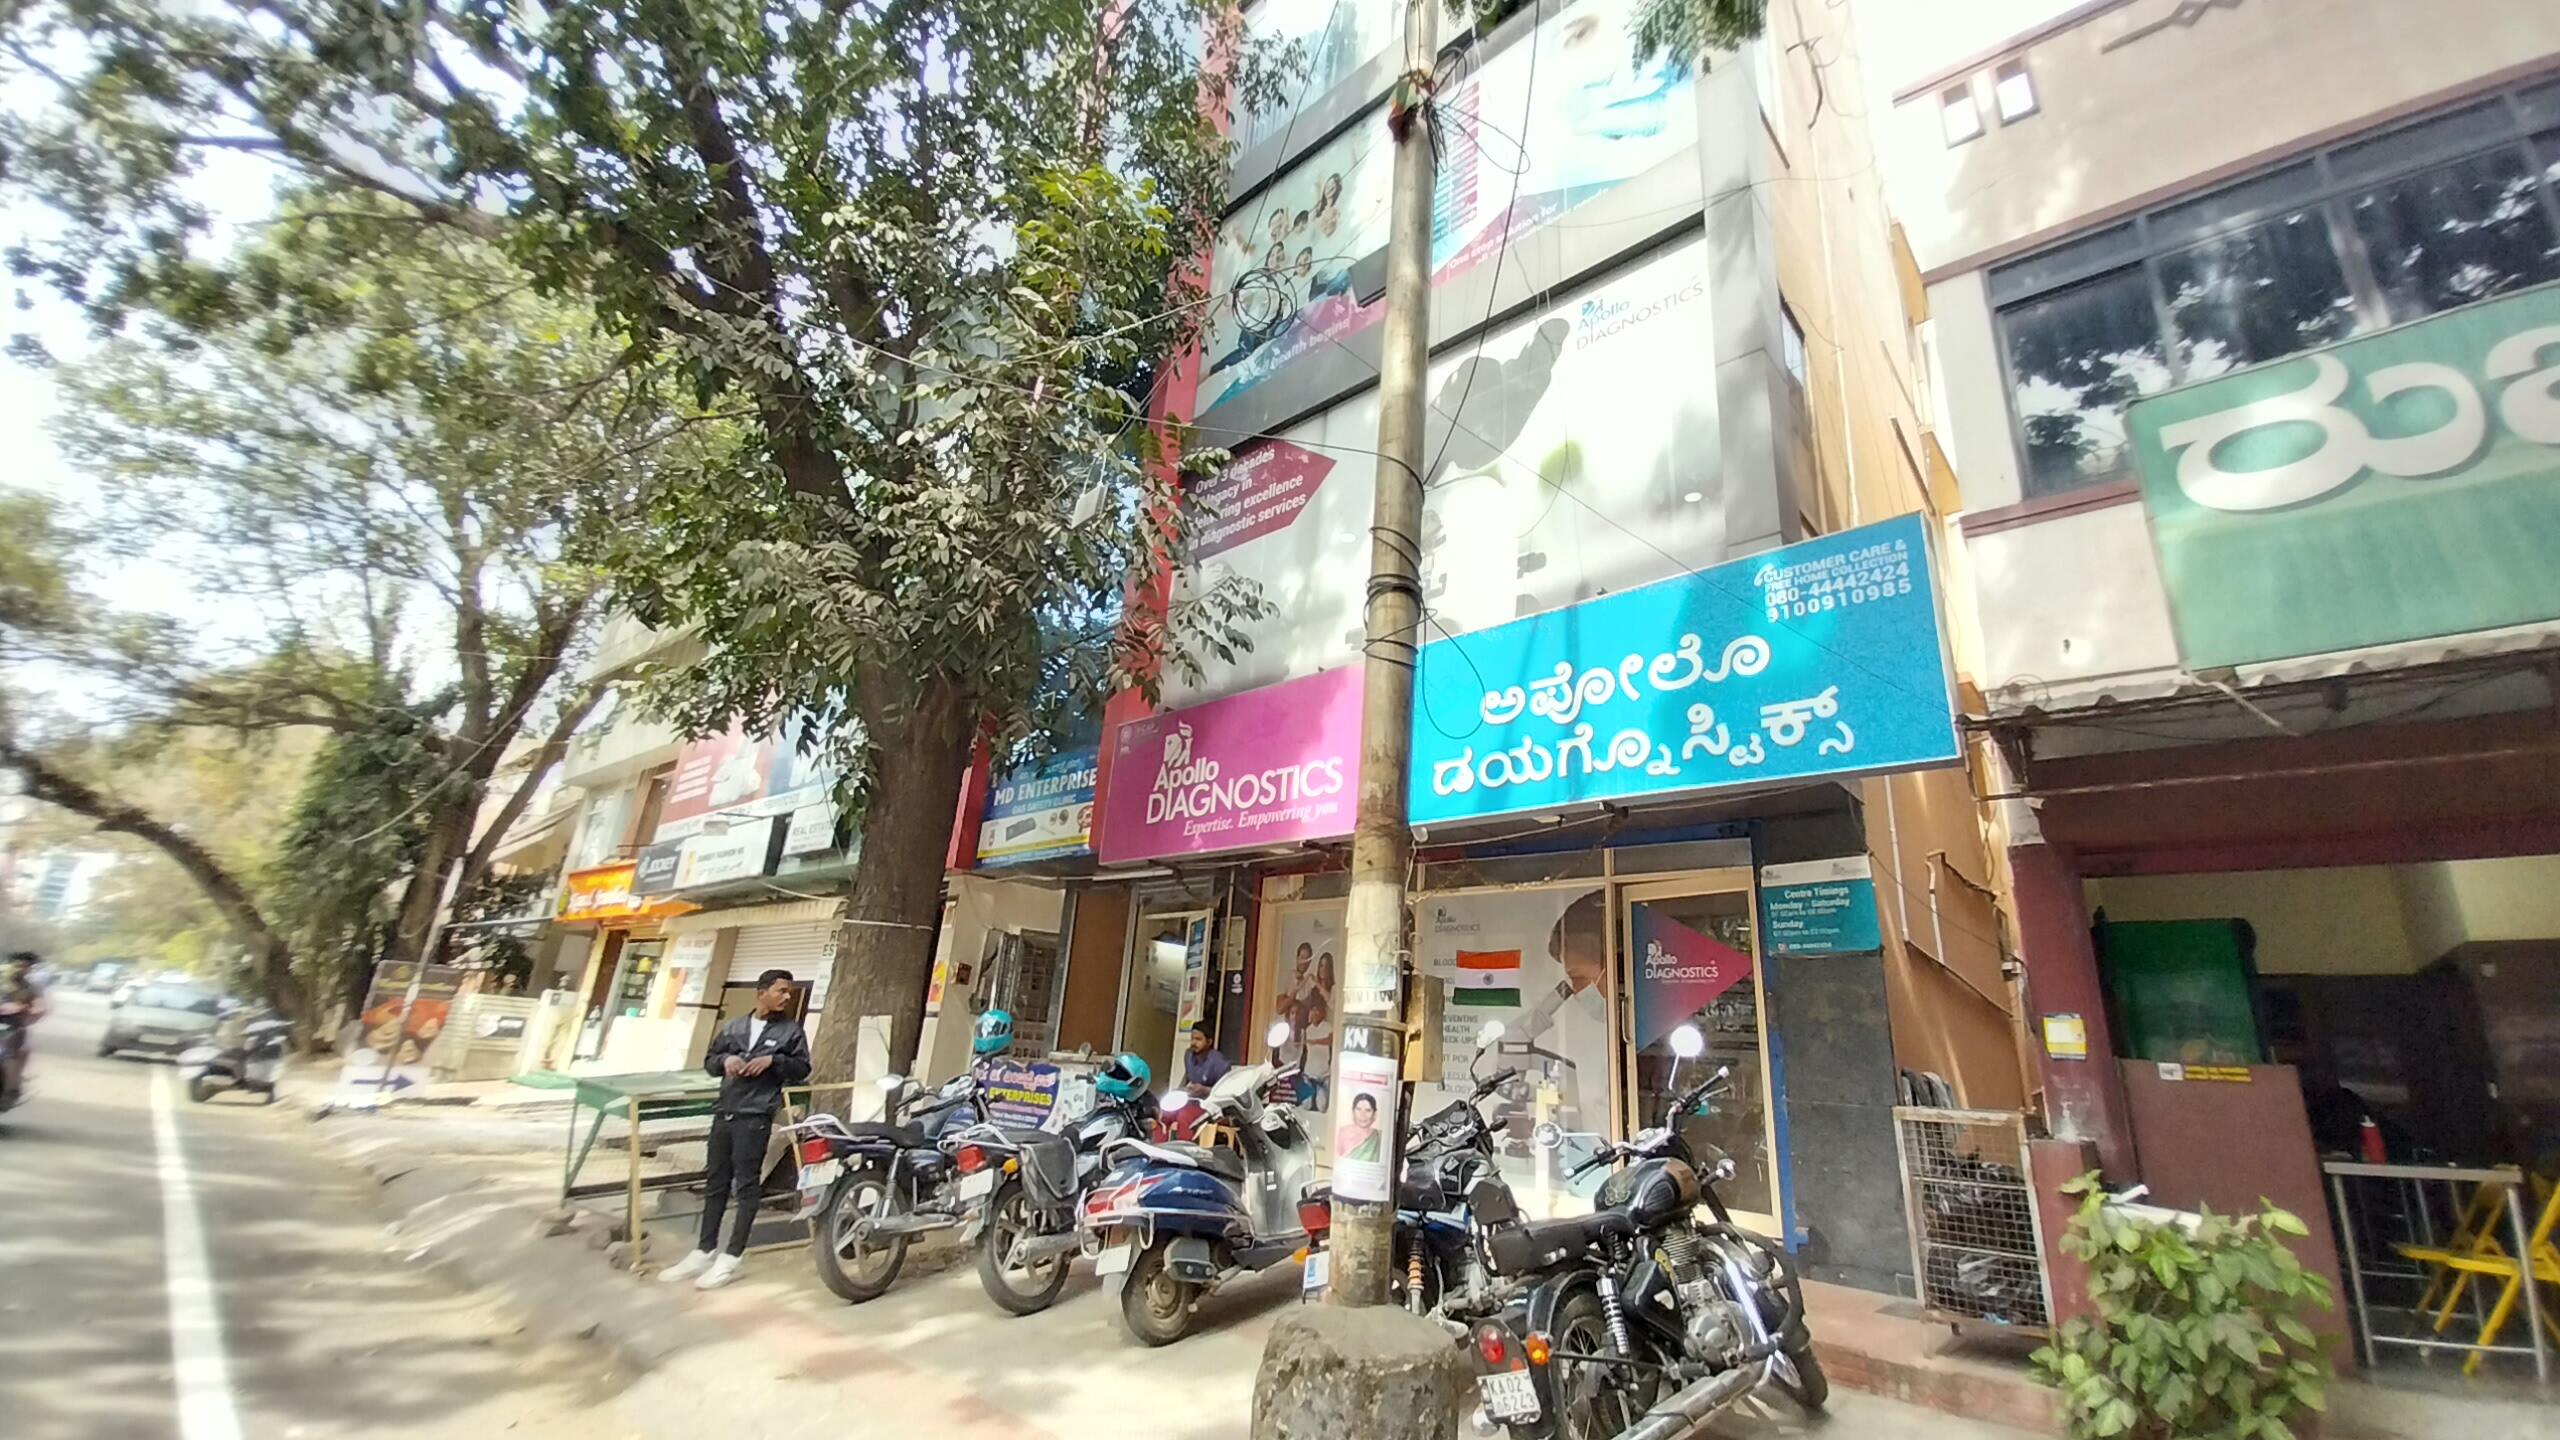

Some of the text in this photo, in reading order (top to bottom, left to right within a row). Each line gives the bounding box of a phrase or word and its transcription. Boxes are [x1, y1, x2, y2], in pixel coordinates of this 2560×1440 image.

[1577, 281, 1704, 350] DIAGNOSTICS
[1579, 301, 1630, 334] Apollo
[1220, 468, 1229, 482] 3
[1241, 478, 1253, 492] in
[1243, 474, 1304, 509] excellence
[1200, 512, 1257, 546] diagnostic
[1257, 493, 1307, 523] services
[1763, 539, 1908, 583] CUSTOMER CARE &
[1793, 570, 1830, 586] HOME
[1830, 550, 1909, 578] COLLECTION
[1764, 561, 1911, 608] 080-44442424
[1766, 578, 1914, 624] 9100910985
[1479, 632, 1772, 726] ಅಪೋಲೊ
[1146, 756, 1344, 825] DIAGNOSTICS
[1153, 756, 1220, 793] Apollo
[993, 786, 1016, 807] MD
[1237, 804, 1313, 831] Empowering
[1772, 919, 1804, 929] Sunday
[1645, 965, 1719, 980] DIAGNOSTICS
[1443, 1014, 1479, 1023] EVENTIVE
